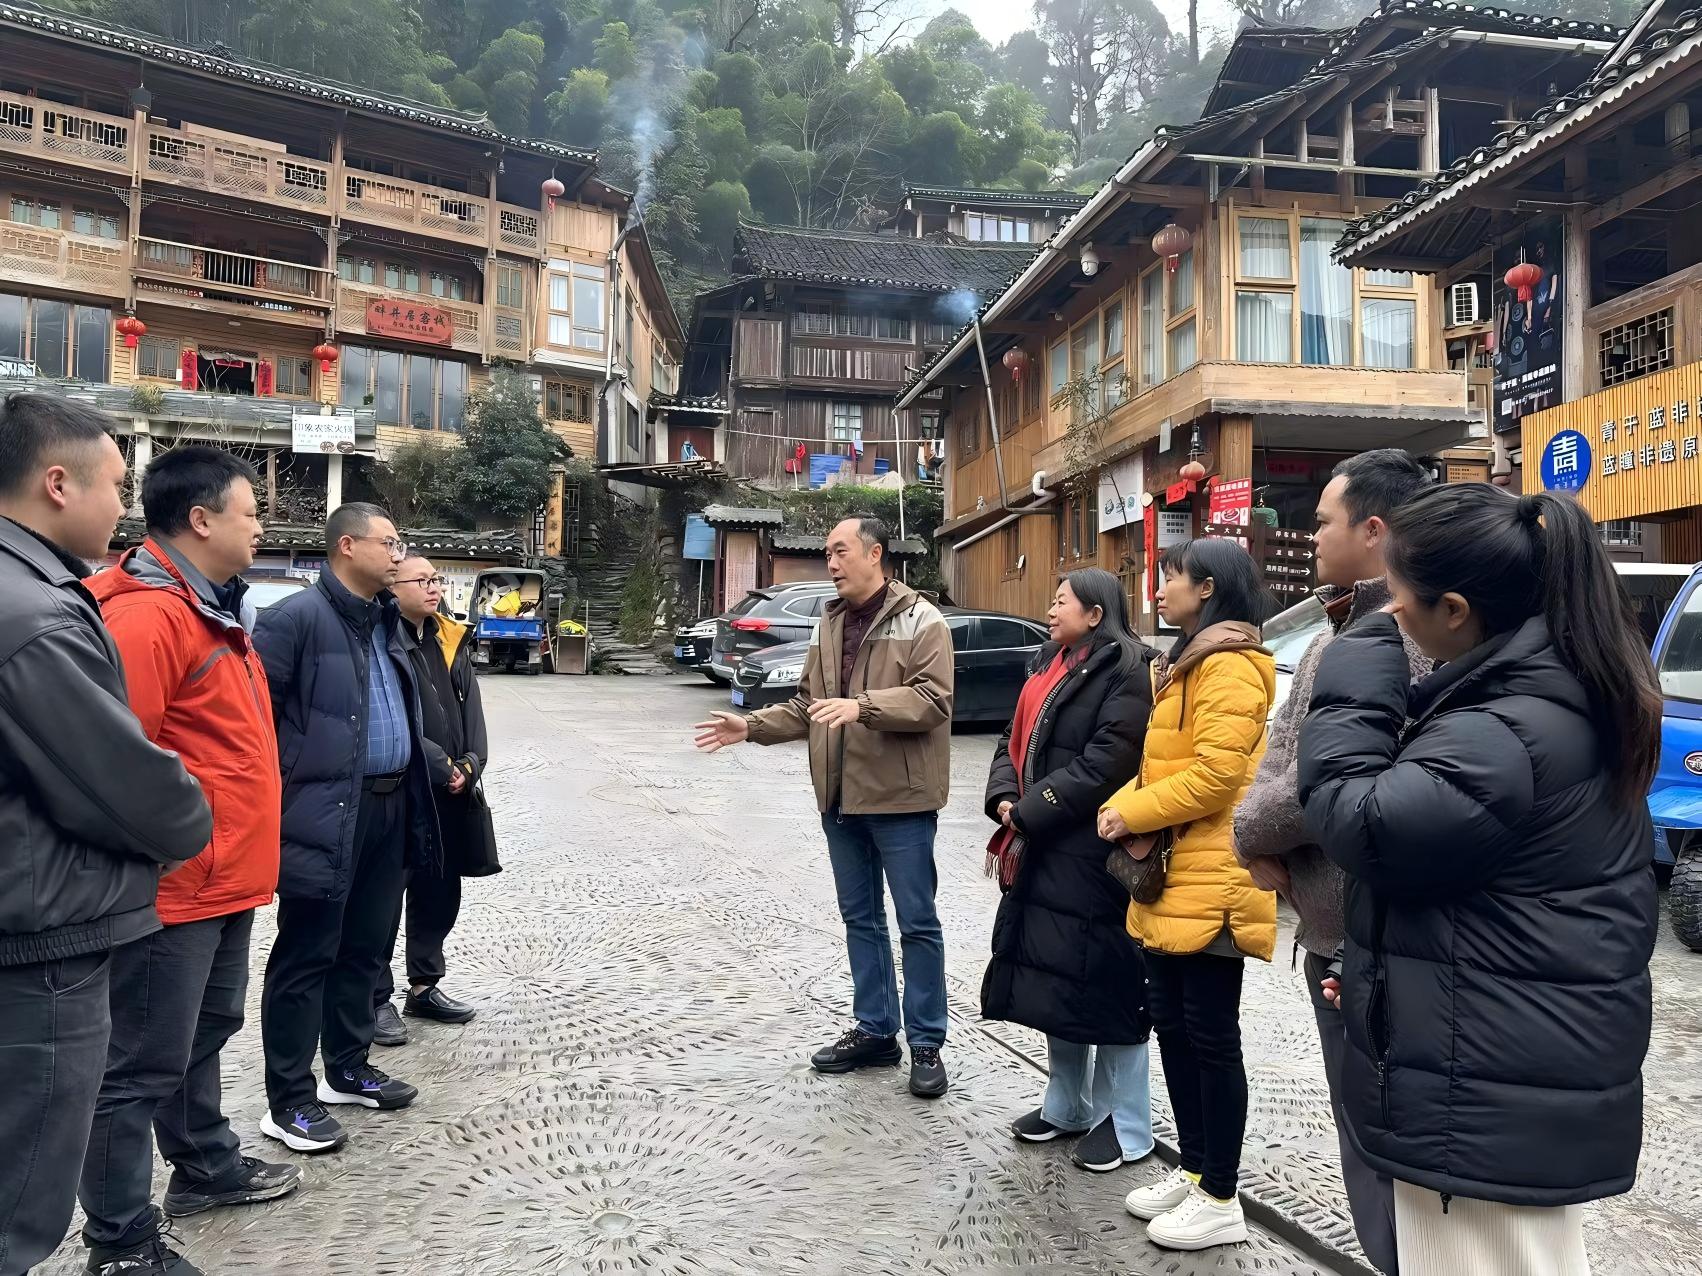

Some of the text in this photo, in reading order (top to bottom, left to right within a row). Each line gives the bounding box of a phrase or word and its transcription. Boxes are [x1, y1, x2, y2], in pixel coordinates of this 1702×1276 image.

[1602, 435, 1698, 476] 蓝瞳非遗原
